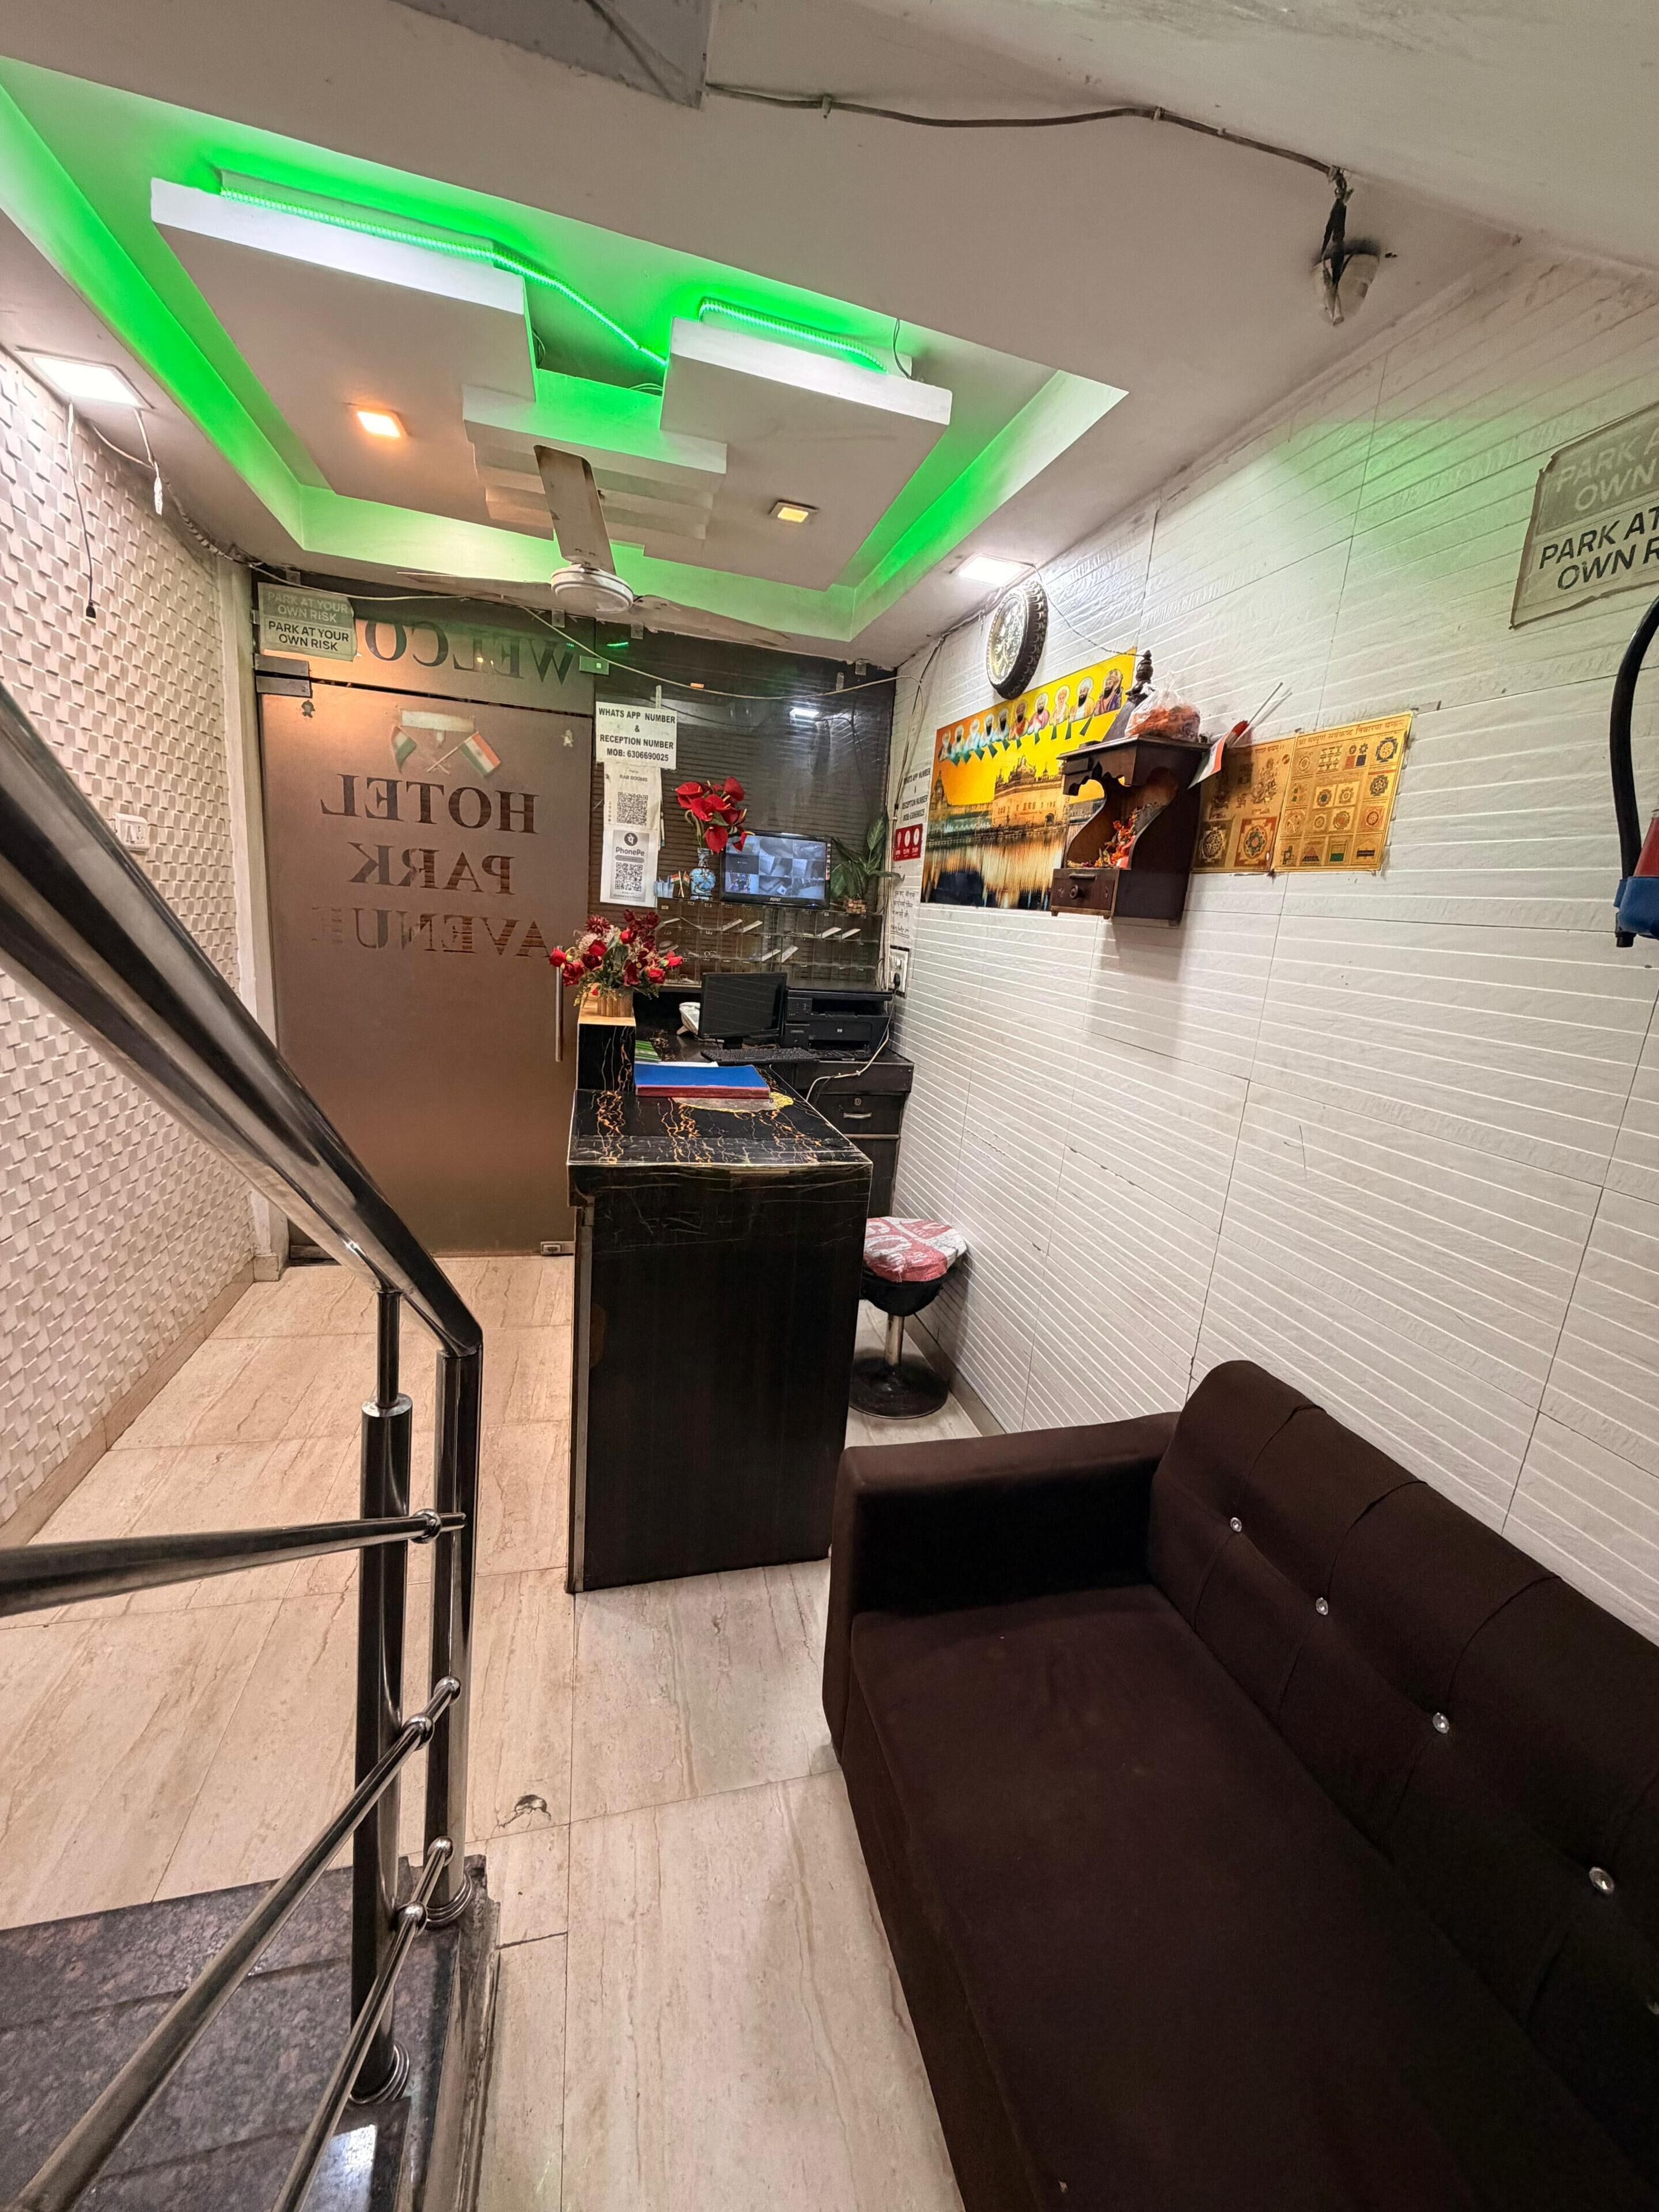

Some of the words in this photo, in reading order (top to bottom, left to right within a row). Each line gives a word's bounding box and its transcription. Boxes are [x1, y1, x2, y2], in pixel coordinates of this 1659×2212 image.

[1556, 435, 1641, 492] PARK
[1574, 458, 1657, 511] OWN
[1539, 520, 1620, 569] PARK
[1623, 506, 1659, 540] AT
[1557, 544, 1636, 590] OWN
[268, 592, 298, 605] PARK
[300, 597, 315, 607] AT
[317, 600, 348, 613] YOUR
[278, 605, 307, 618] OWN
[310, 610, 336, 623] RISK
[268, 620, 299, 634] PARK
[301, 626, 315, 637] AT
[318, 629, 349, 642] YOUR
[279, 634, 308, 646] OWN
[311, 639, 338, 651] RISK
[599, 707, 624, 718] WHATS
[626, 711, 641, 719] APP
[645, 713, 675, 724] NUMBER
[600, 734, 641, 746] RECEPTION
[643, 739, 673, 749] NUMBER
[607, 748, 625, 757] MOB:
[627, 750, 669, 762] 6306690025
[615, 846, 645, 857] PhonePe
